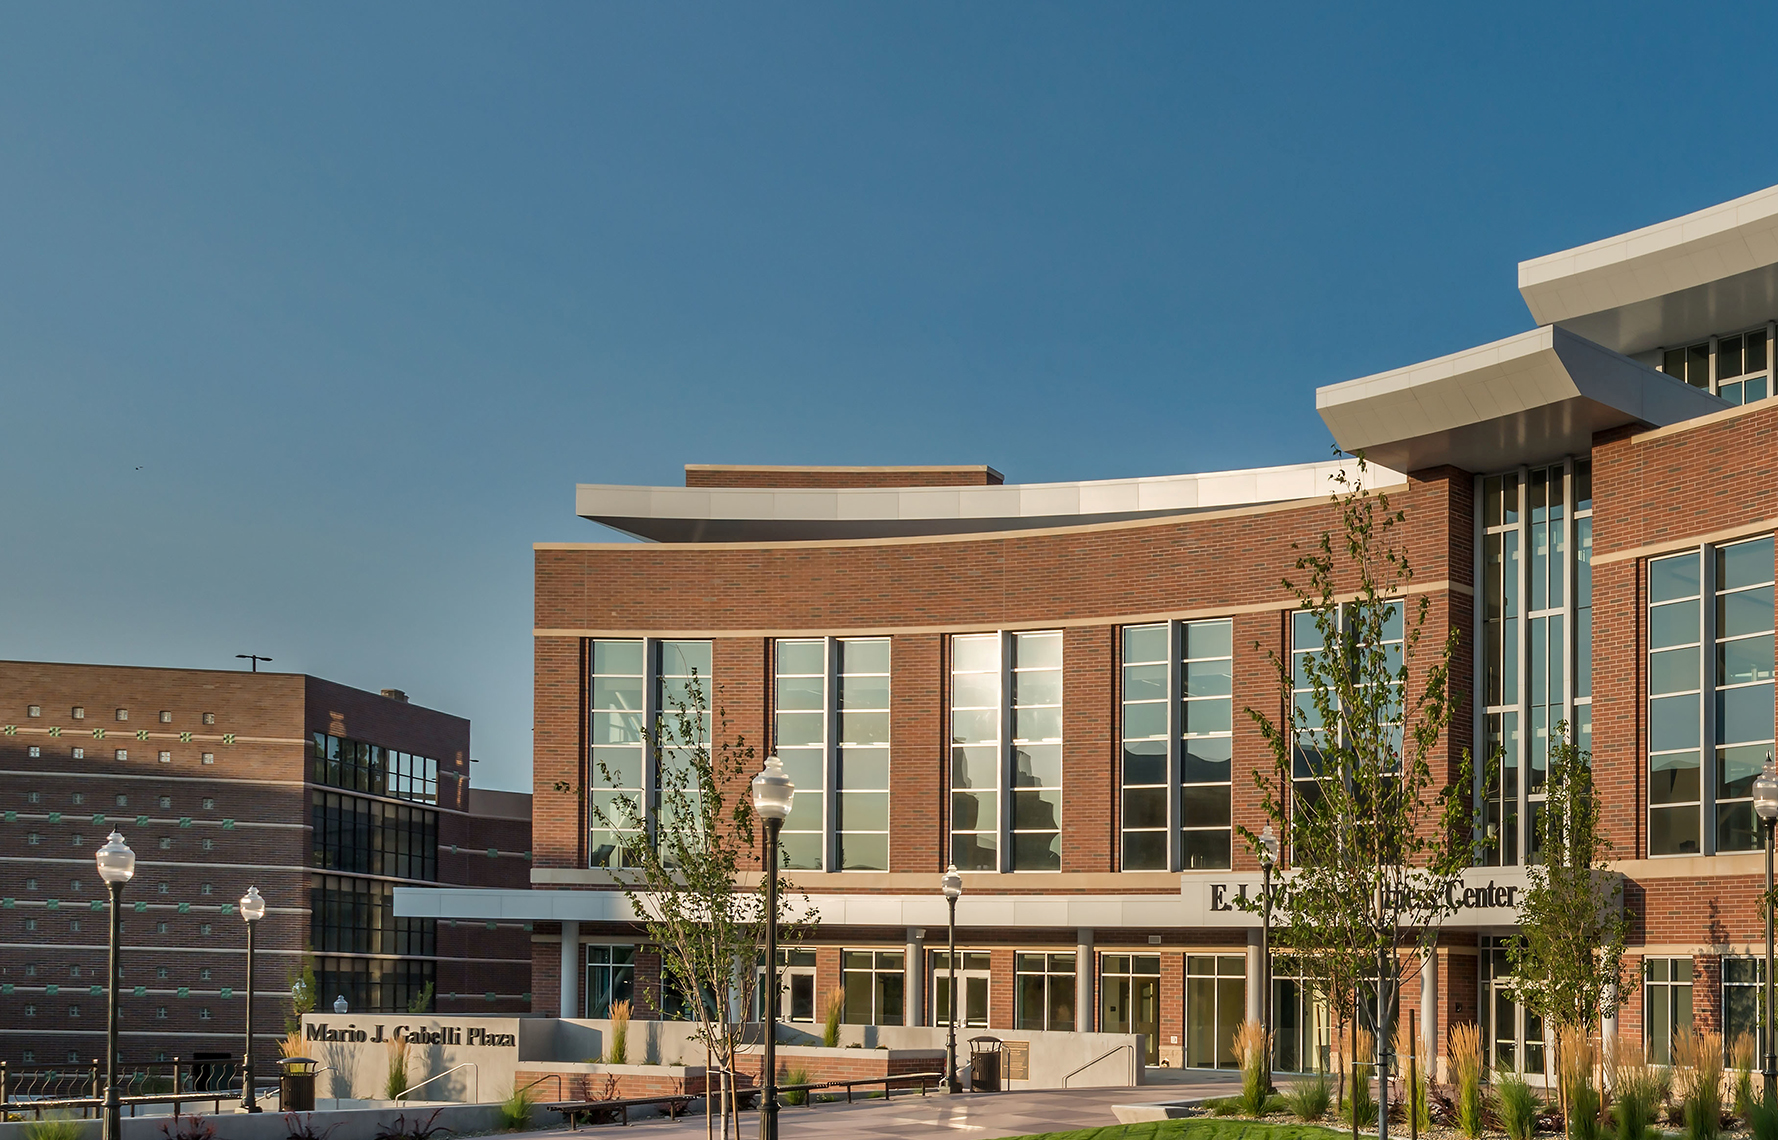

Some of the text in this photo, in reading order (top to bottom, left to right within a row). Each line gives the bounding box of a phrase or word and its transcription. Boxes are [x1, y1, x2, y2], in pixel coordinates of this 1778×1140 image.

[1445, 879, 1518, 909] Center
[306, 1023, 516, 1046] Mario J. Gabelli Plaza
